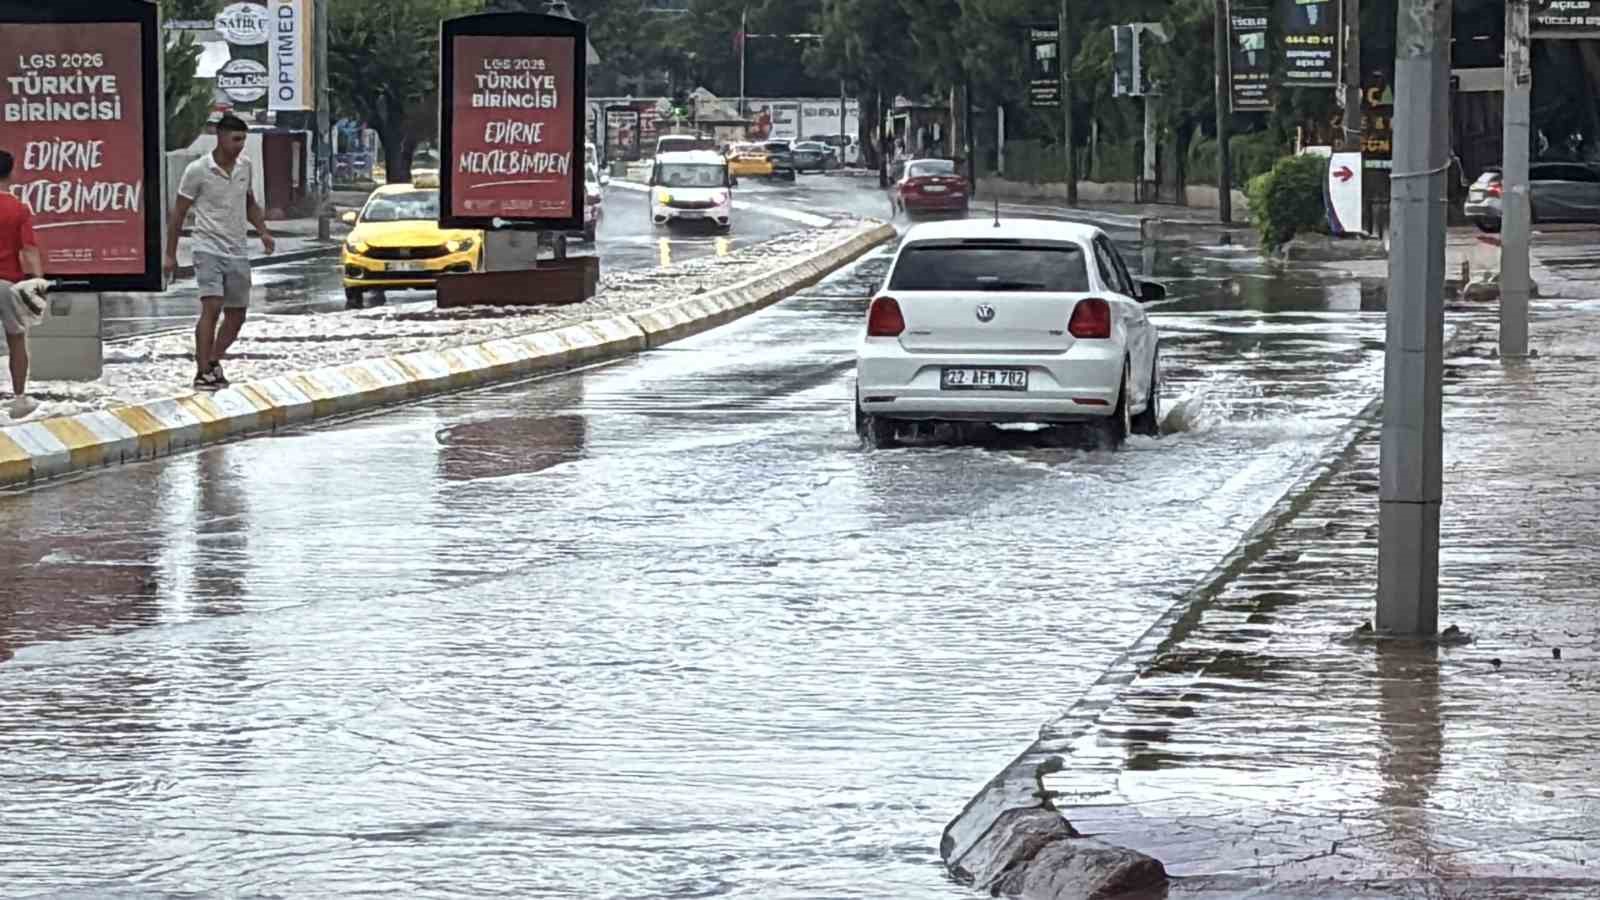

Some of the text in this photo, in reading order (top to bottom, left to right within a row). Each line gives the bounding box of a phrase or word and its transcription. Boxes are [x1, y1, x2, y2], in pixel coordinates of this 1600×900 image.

[19, 53, 104, 69] LGS 2026
[483, 59, 511, 70] LGS
[7, 70, 117, 95] TÜRKİYE
[475, 71, 555, 89] TÜRKİYE
[4, 96, 121, 122] BİRİNCİSİ
[472, 90, 557, 109] BİRİNCİSİ
[484, 119, 545, 144] EDİRNE
[23, 137, 104, 172] EDİRNE
[458, 149, 570, 175] MEKTEBİMDEN
[946, 370, 965, 384] 22
[972, 371, 996, 384] AFM
